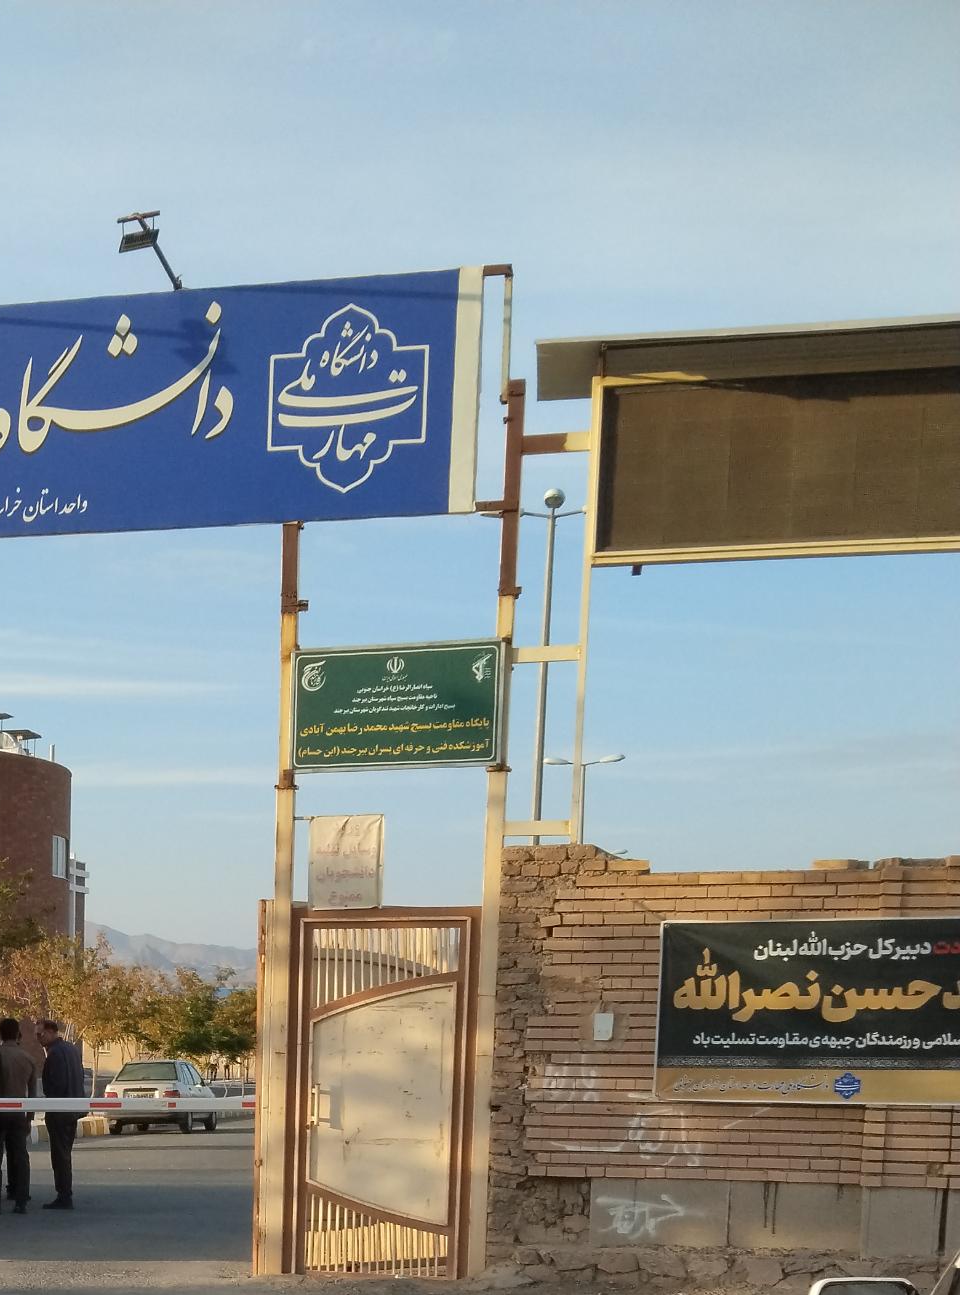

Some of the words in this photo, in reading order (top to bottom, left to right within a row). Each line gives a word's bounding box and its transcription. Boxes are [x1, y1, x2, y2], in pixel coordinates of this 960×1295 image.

[319, 321, 379, 377] دانشگاه
[22, 488, 59, 523] استان
[58, 493, 88, 516] واحد
[363, 723, 388, 732] محمد
[388, 721, 410, 733] شهید
[410, 721, 432, 733] بسیج
[432, 719, 464, 732] مقاومت
[465, 717, 490, 730] پایگاه
[341, 746, 368, 757] بیرجند
[404, 742, 425, 755] حرفه
[431, 741, 448, 754] فنی
[448, 738, 490, 752] آموزشکده
[753, 939, 798, 962] لبنان
[821, 979, 943, 1023] حسن
[692, 1032, 711, 1049] باد
[711, 1032, 756, 1050] تسلیت
[756, 1032, 809, 1049] مقاومت
